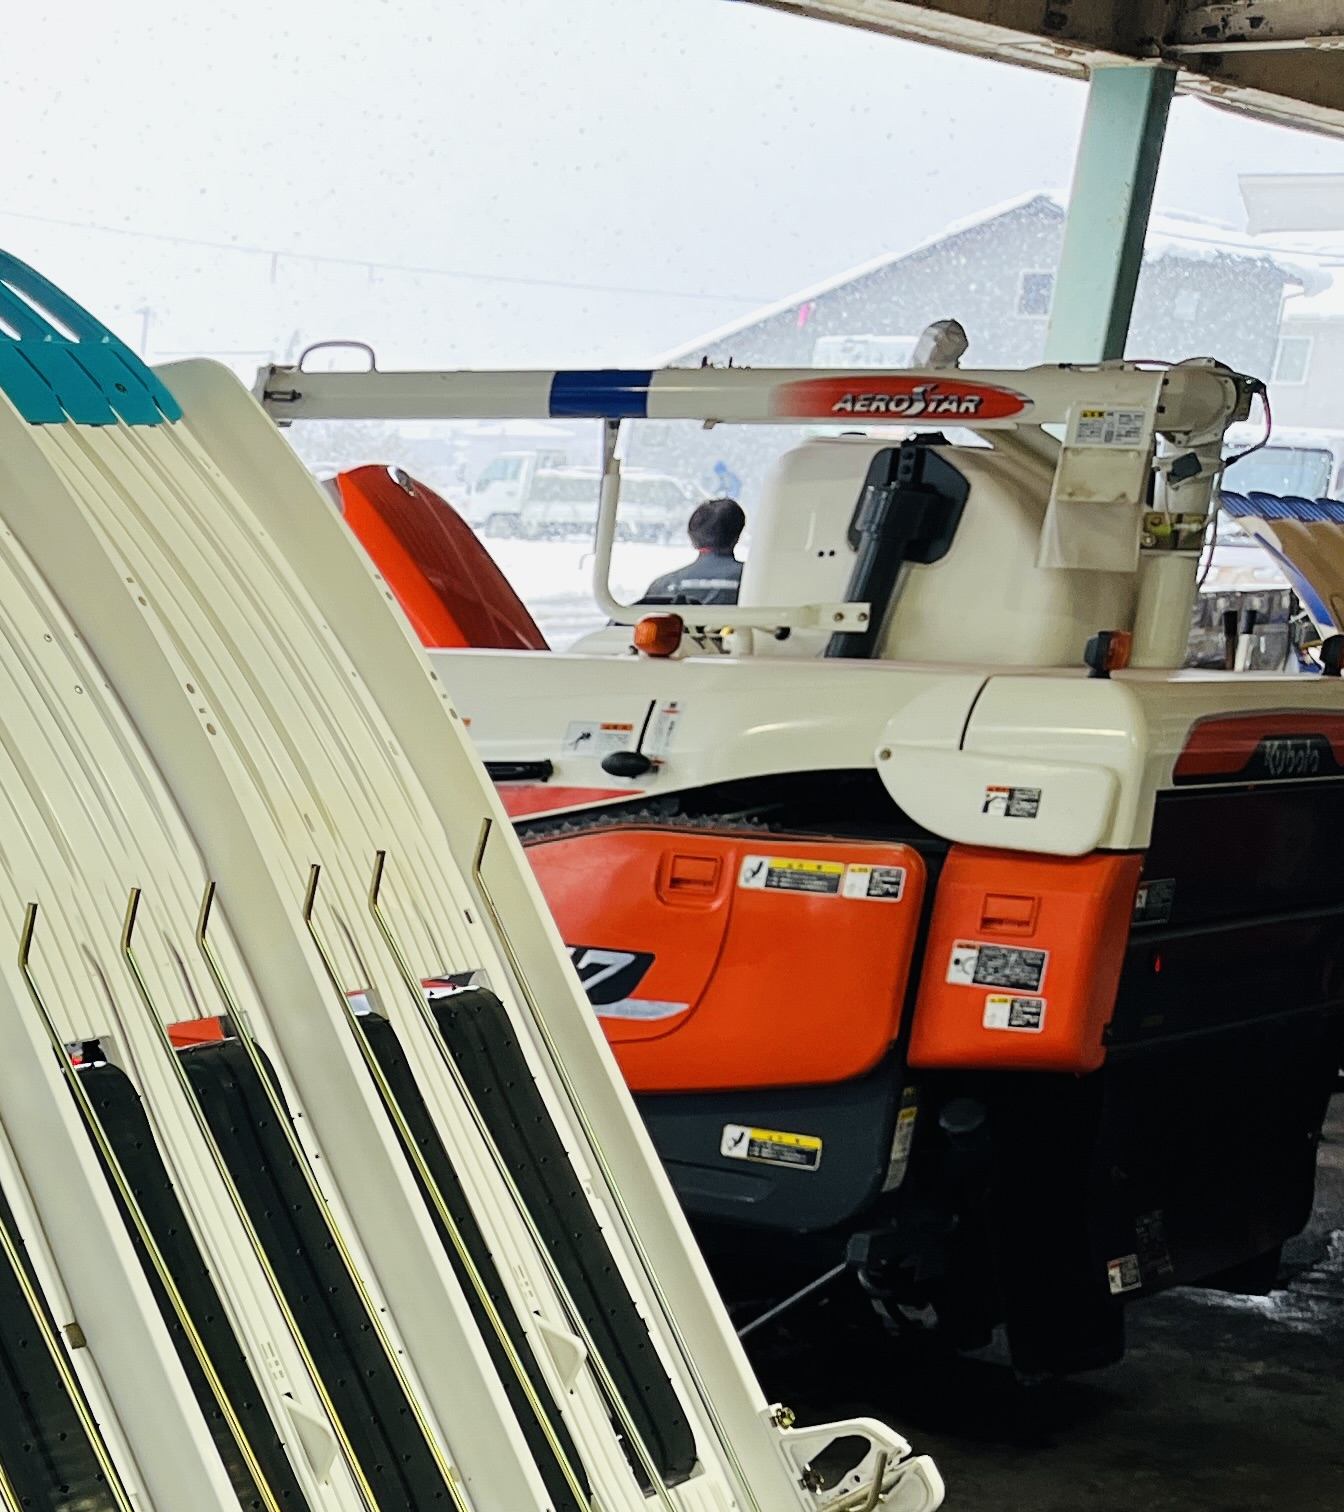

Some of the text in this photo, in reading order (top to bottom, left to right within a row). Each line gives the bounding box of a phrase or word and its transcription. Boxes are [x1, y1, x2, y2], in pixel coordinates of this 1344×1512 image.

[831, 383, 982, 415] AEROSTAR
[1263, 739, 1319, 775] Kubota
[566, 946, 637, 991] 7
